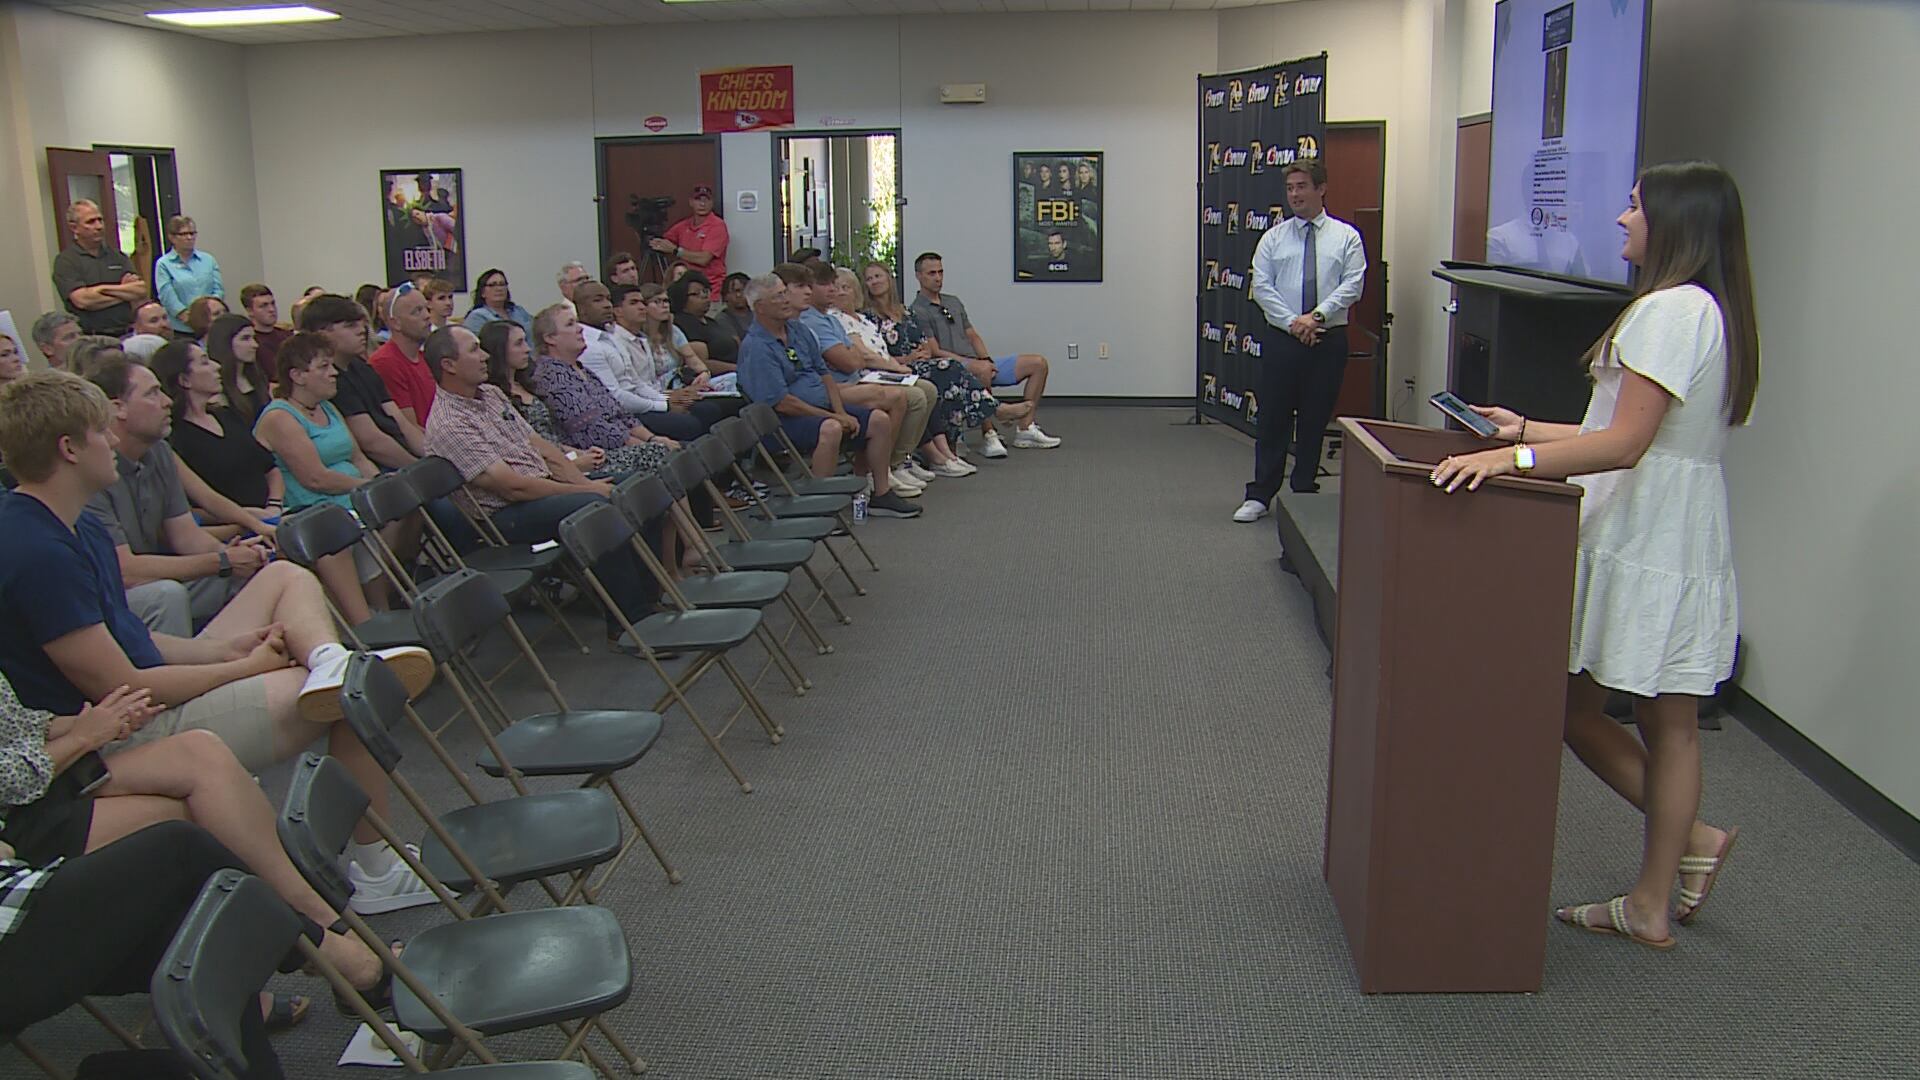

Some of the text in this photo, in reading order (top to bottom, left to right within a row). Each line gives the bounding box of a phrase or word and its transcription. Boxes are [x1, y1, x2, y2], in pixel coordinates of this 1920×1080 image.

[719, 72, 774, 91] CHIEFS
[707, 89, 787, 111] KINGDOM
[1037, 201, 1079, 221] FBI:
[404, 249, 446, 271] ELSBETH
